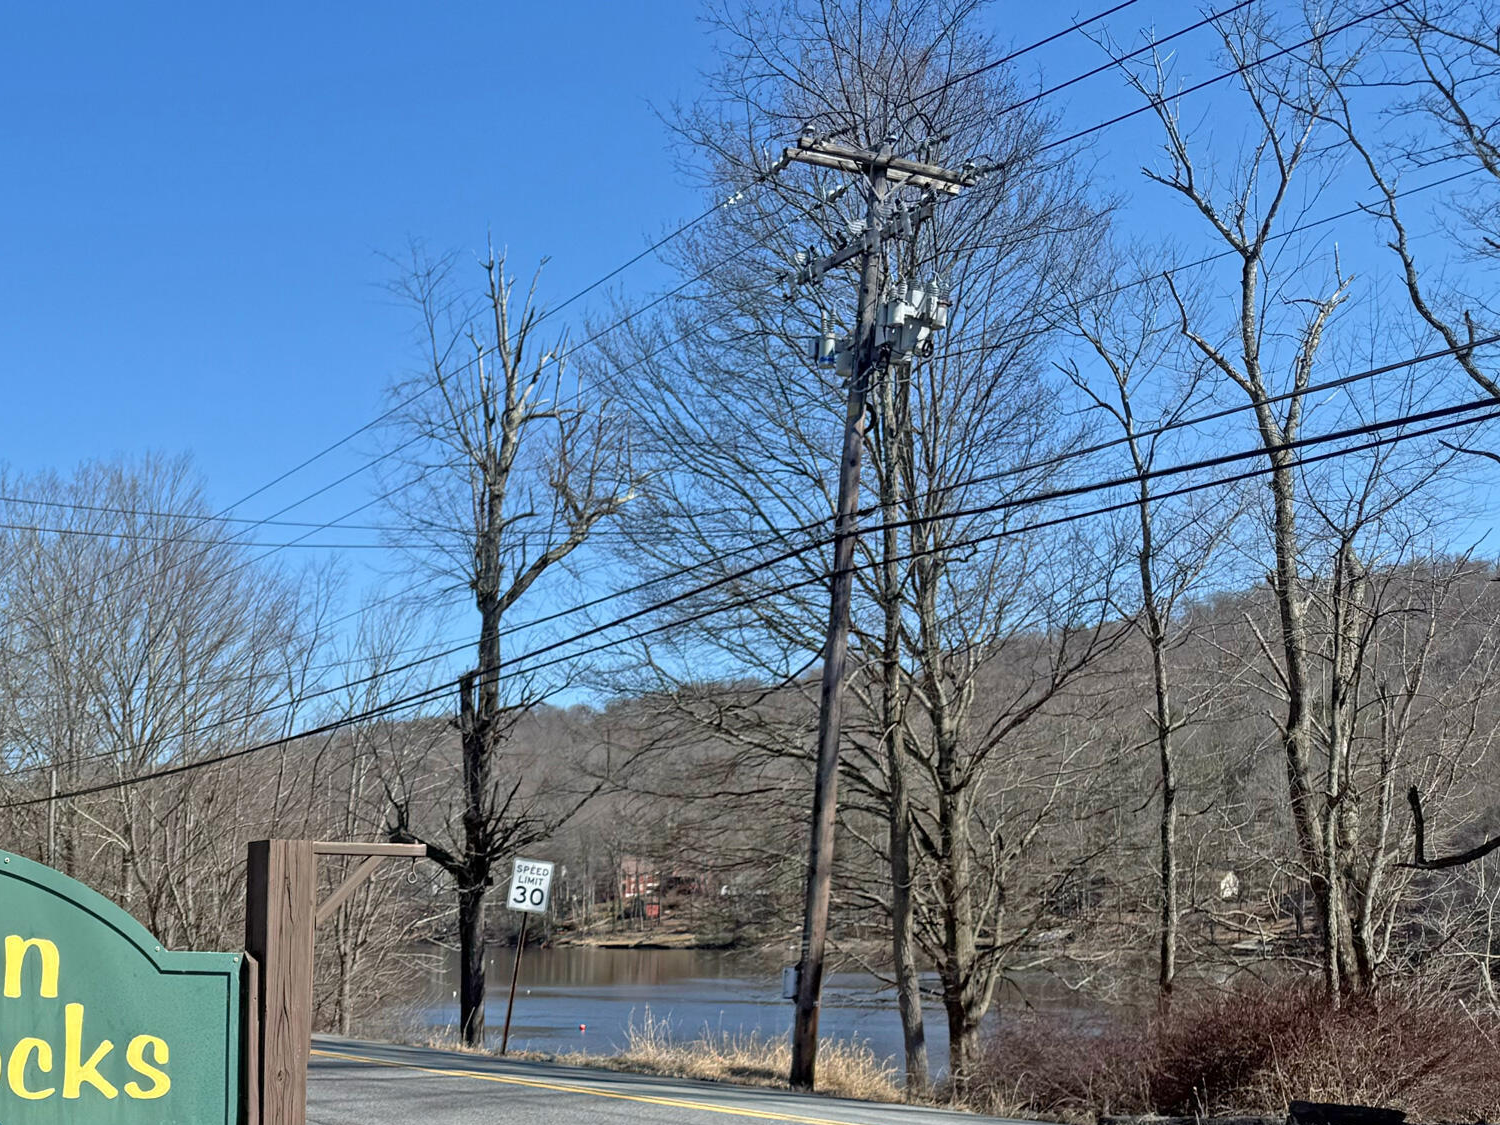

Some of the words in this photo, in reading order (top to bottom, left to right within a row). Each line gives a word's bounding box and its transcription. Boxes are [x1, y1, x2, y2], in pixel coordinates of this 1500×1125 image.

[516, 864, 550, 877] SPEED
[518, 875, 544, 886] LIMIT
[512, 885, 545, 906] 30
